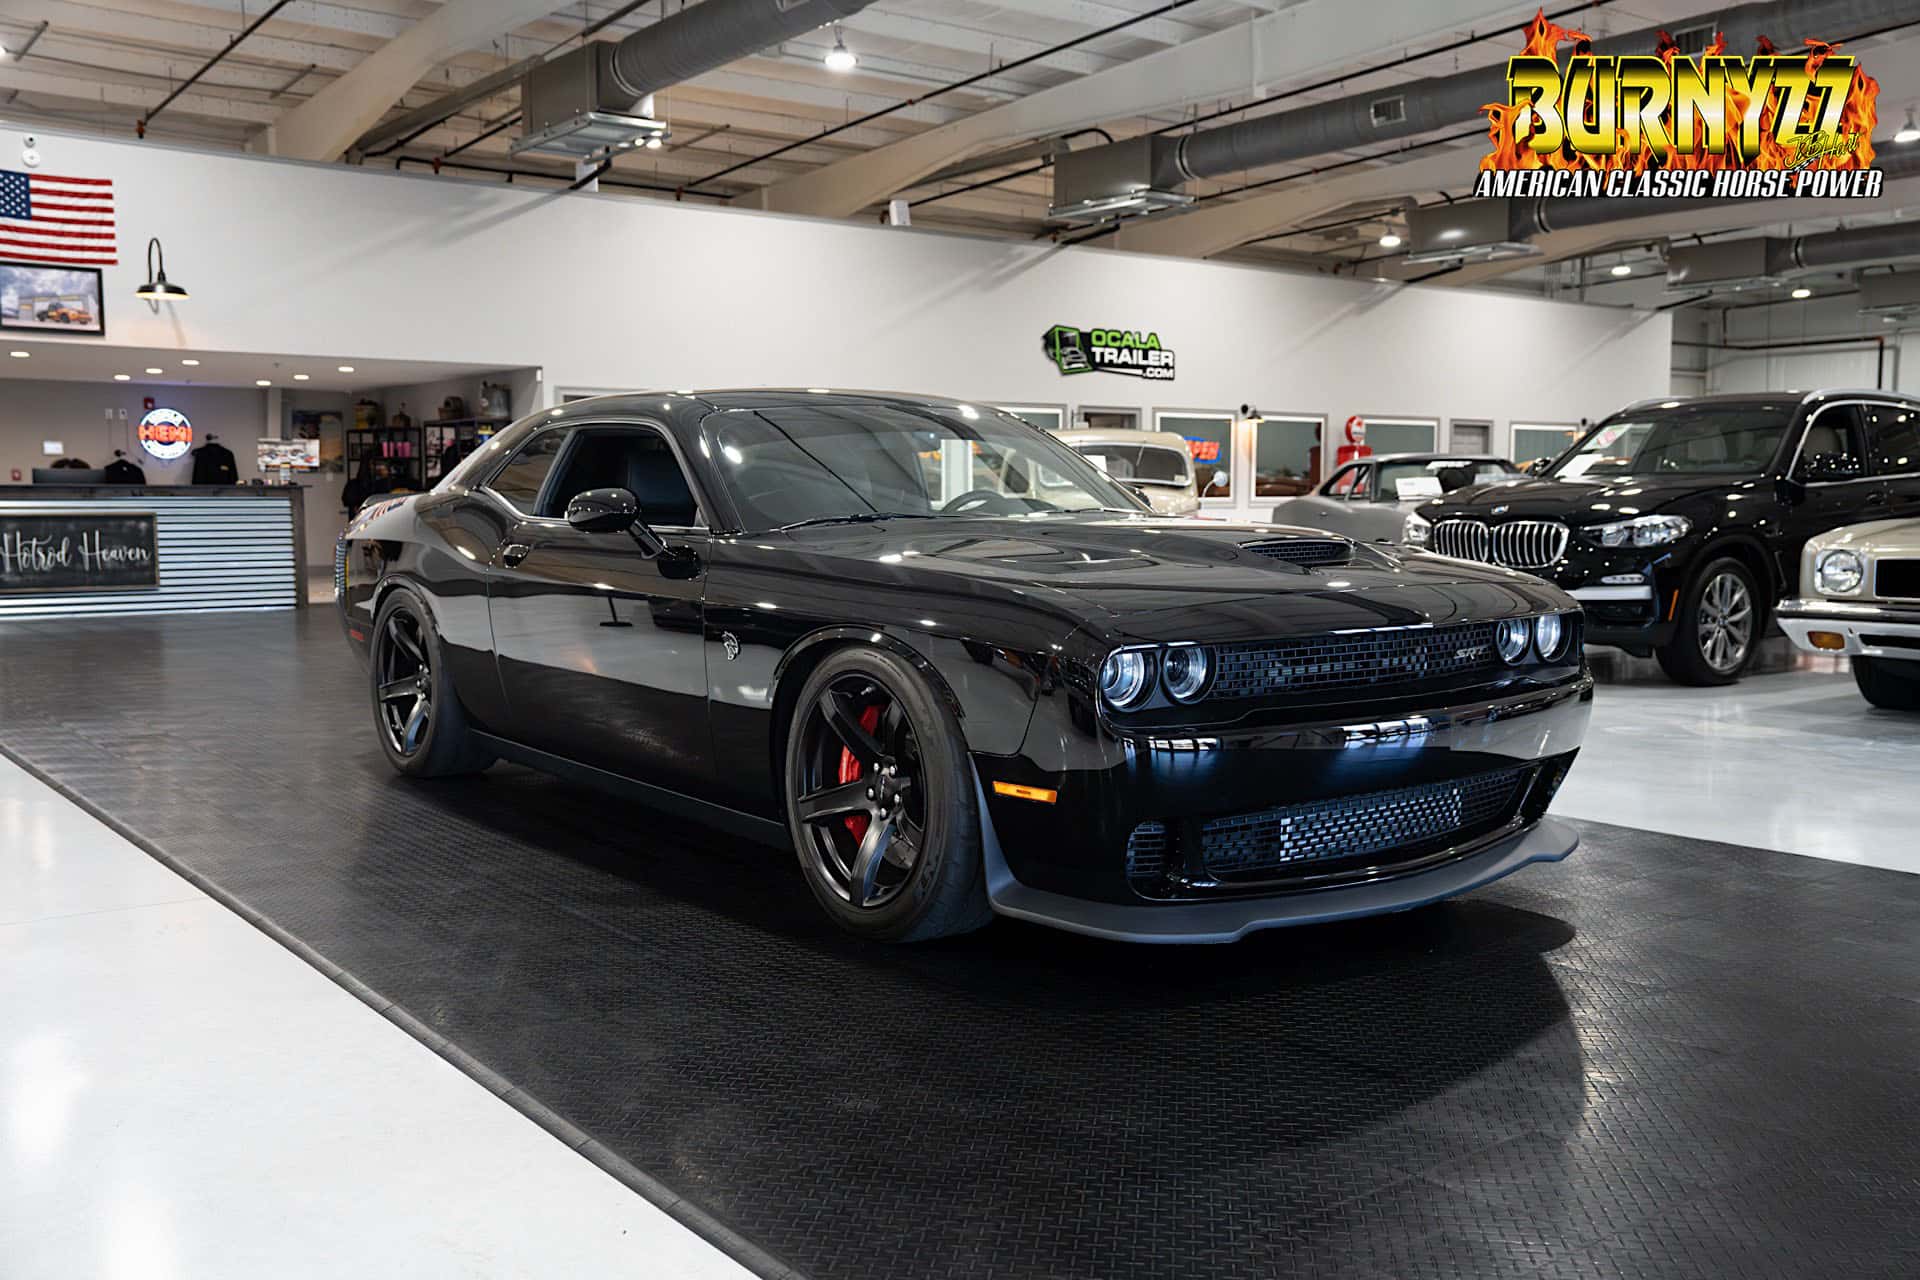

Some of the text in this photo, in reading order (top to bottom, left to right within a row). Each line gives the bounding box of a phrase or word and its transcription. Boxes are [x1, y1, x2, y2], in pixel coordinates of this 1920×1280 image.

[1090, 328, 1161, 349] OCALA
[1090, 346, 1174, 367] TRAILER
[1141, 366, 1174, 379] .COM
[0, 528, 152, 573] Hotrod Heaven
